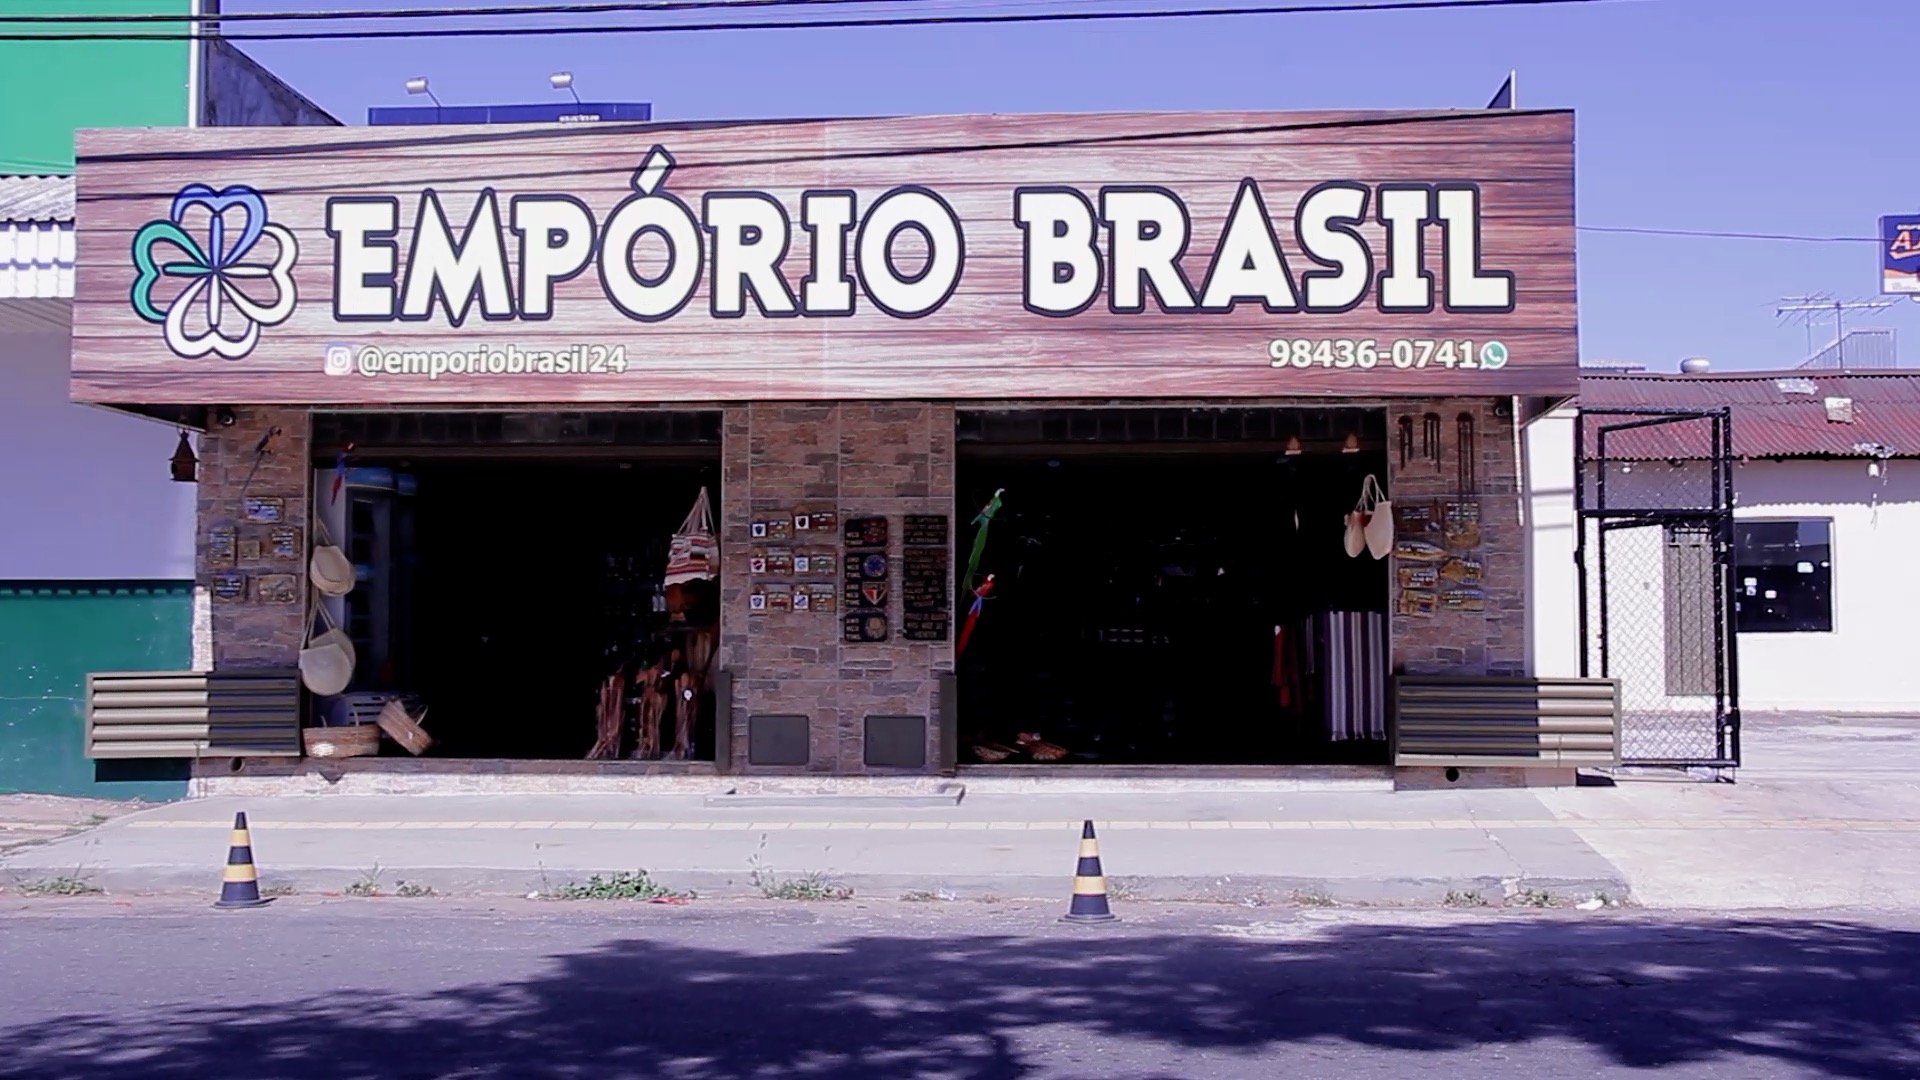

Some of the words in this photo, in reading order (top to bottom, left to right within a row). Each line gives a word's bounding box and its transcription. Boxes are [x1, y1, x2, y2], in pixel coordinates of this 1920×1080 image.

[327, 145, 965, 327] EMPÓRIO
[1014, 177, 1516, 317] BRASIL
[358, 343, 628, 380] @emporiobrasil24
[1269, 338, 1479, 370] 98436-0741
